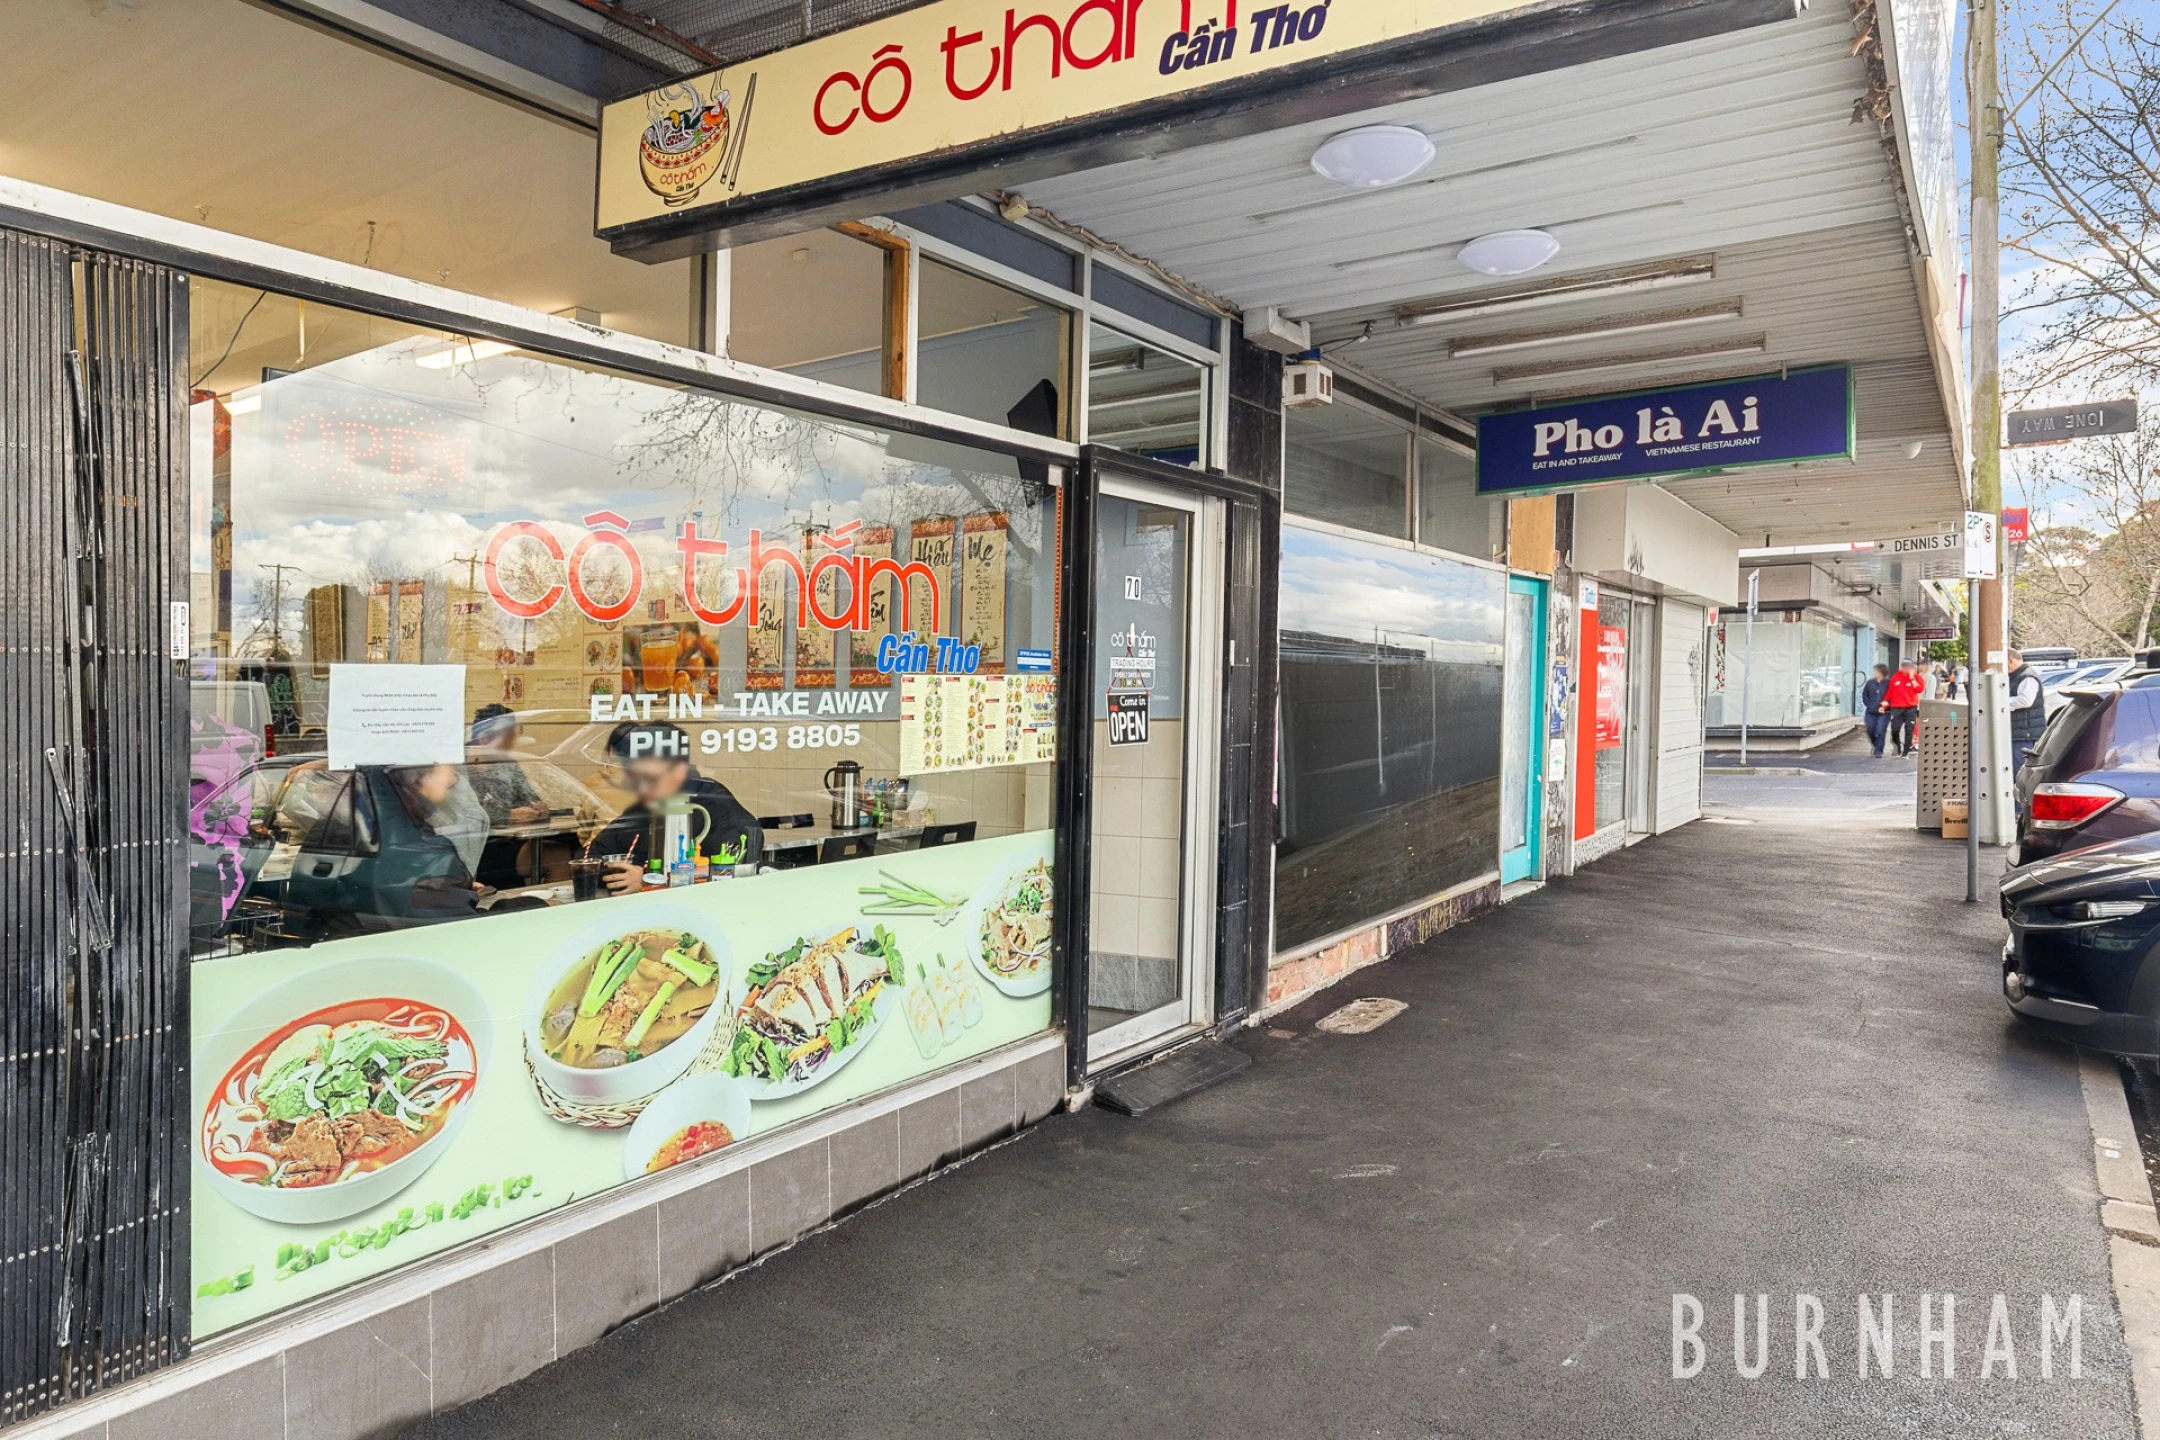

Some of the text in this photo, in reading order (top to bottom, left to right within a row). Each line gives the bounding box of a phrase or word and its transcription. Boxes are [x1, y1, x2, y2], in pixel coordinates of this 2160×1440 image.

[1159, 0, 1331, 76] Cần Thơ
[814, 43, 912, 136] cô
[1532, 396, 1758, 457] Pho là Ai
[1532, 452, 1623, 470] EAT IN AND TAKEAWAY
[1645, 436, 1762, 457] VIETNAMESE RESTAURANT
[1894, 536, 1939, 552] DENNIS
[1943, 534, 1959, 548] ST
[484, 509, 643, 623] cô
[675, 518, 941, 634] thắm
[1126, 578, 1140, 598] 70
[877, 631, 982, 674] Cần Thơ
[591, 694, 659, 721] EAT
[669, 693, 703, 719] IN
[734, 692, 810, 717] TAKE
[816, 691, 889, 715] AWAY
[1119, 695, 1147, 707] Come in
[630, 723, 861, 759] PH: 9193 8805
[1110, 711, 1146, 742] OPEN
